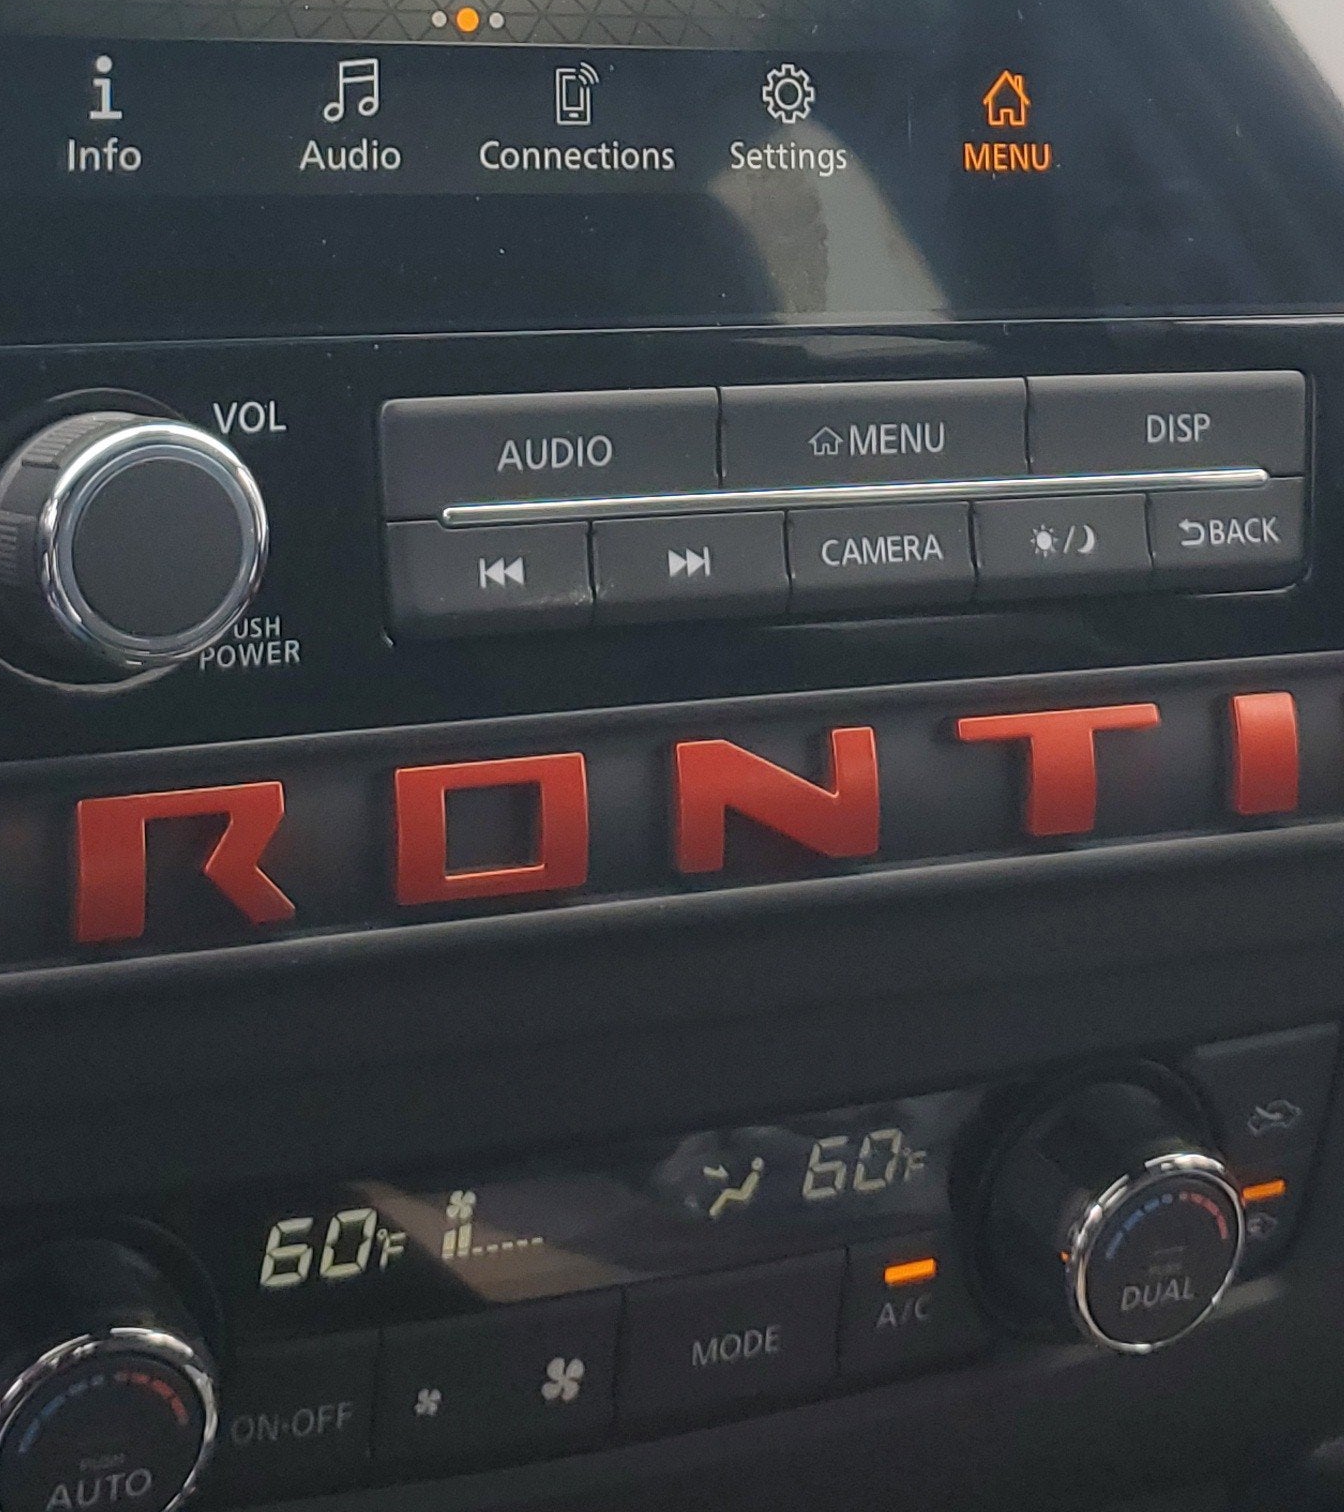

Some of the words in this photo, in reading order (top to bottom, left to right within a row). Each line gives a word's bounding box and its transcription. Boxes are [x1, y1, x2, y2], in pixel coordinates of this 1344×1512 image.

[67, 137, 142, 172] Info
[299, 140, 401, 172] Audio
[479, 141, 675, 171] Connections
[730, 141, 847, 176] Settings
[963, 143, 1052, 171] MENU
[213, 401, 287, 434] VOL
[1147, 414, 1210, 443] DISP
[497, 434, 613, 473] AUDIO
[850, 423, 945, 455] MENU
[1211, 517, 1279, 545] BACK
[821, 534, 943, 566] CAMERA
[234, 615, 281, 639] USH
[199, 639, 301, 670] POWER
[1120, 1276, 1194, 1311] DUAL
[875, 1296, 931, 1329] A/C
[691, 1325, 782, 1368] MODE
[46, 1468, 152, 1512] AUTO
